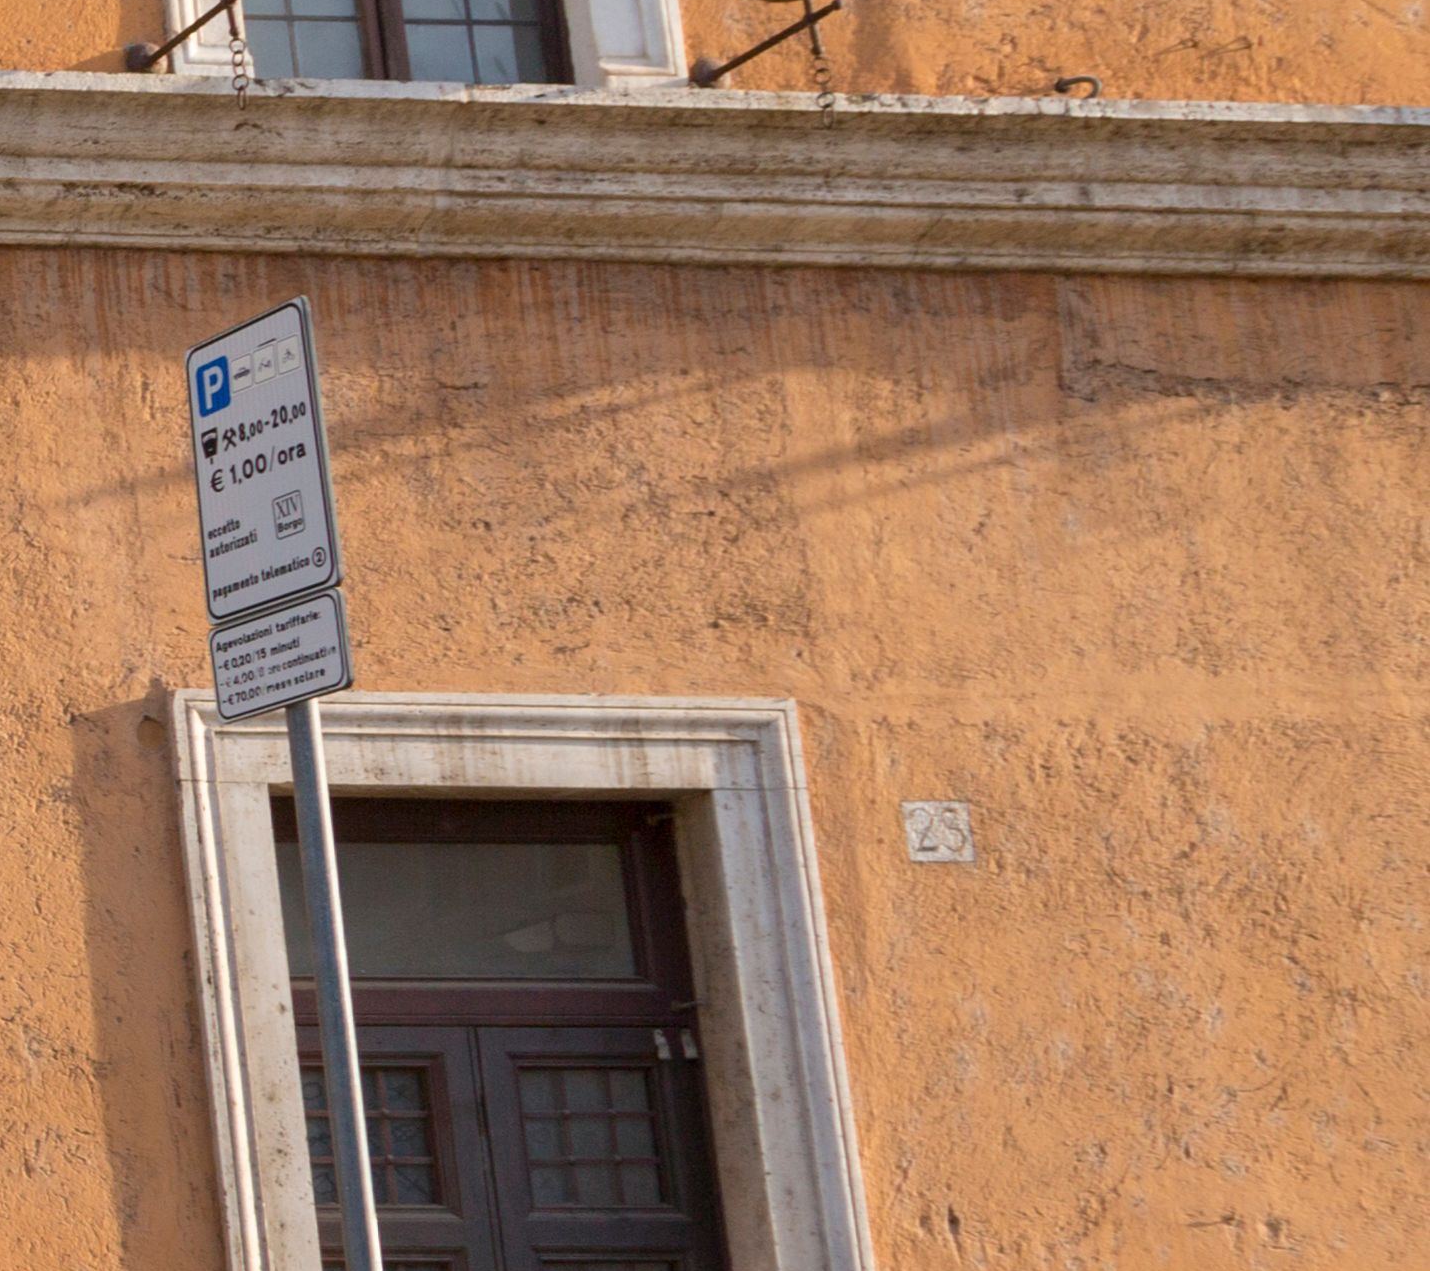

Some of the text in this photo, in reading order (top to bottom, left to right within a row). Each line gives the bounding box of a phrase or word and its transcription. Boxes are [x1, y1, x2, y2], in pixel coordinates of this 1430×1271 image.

[202, 365, 224, 410] P
[275, 494, 301, 520] XIV
[207, 518, 241, 540] eccetto
[277, 518, 303, 533] Borgo
[209, 529, 258, 558] autorizzati
[212, 572, 259, 602] pagamento
[261, 556, 310, 582] telematico
[215, 625, 273, 653] Agevolazioni
[270, 636, 300, 657] minuti
[293, 667, 326, 685] solare
[908, 807, 966, 852] 25
